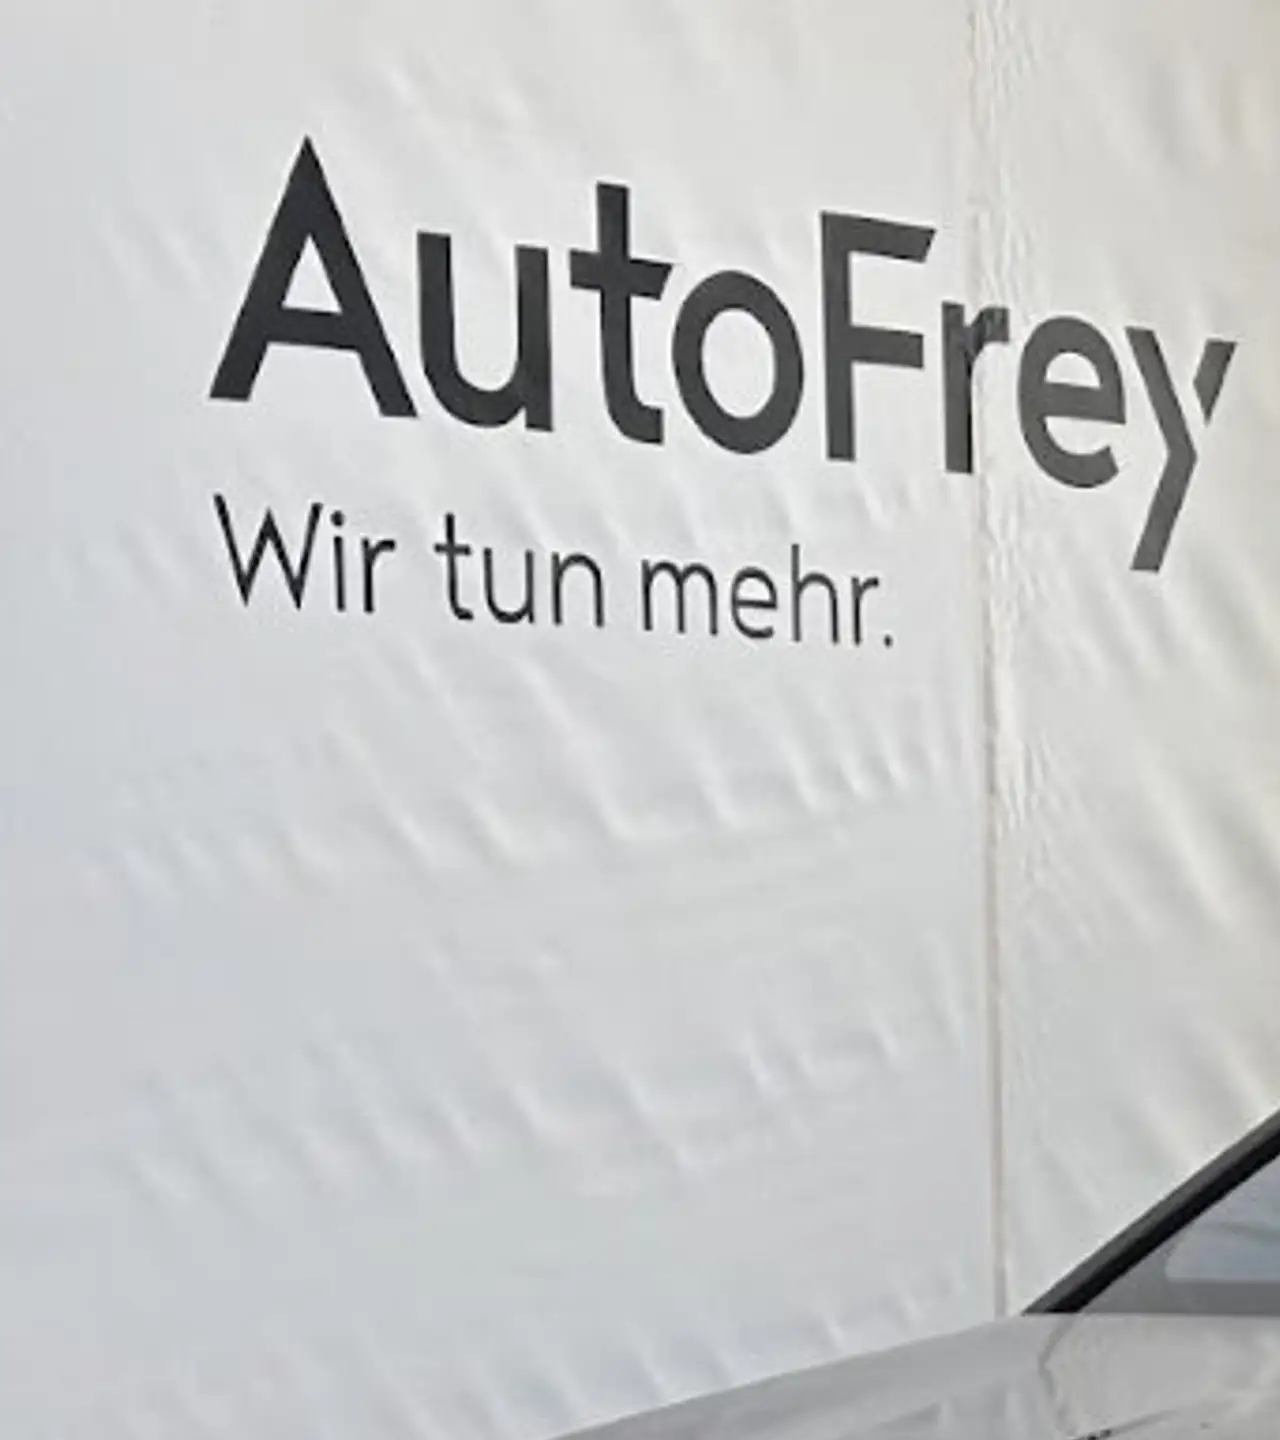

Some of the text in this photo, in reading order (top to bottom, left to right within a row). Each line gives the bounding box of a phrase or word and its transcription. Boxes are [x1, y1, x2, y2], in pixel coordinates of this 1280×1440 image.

[209, 136, 1236, 573] AutoFrey
[213, 493, 893, 648] Wir tun mehr.
